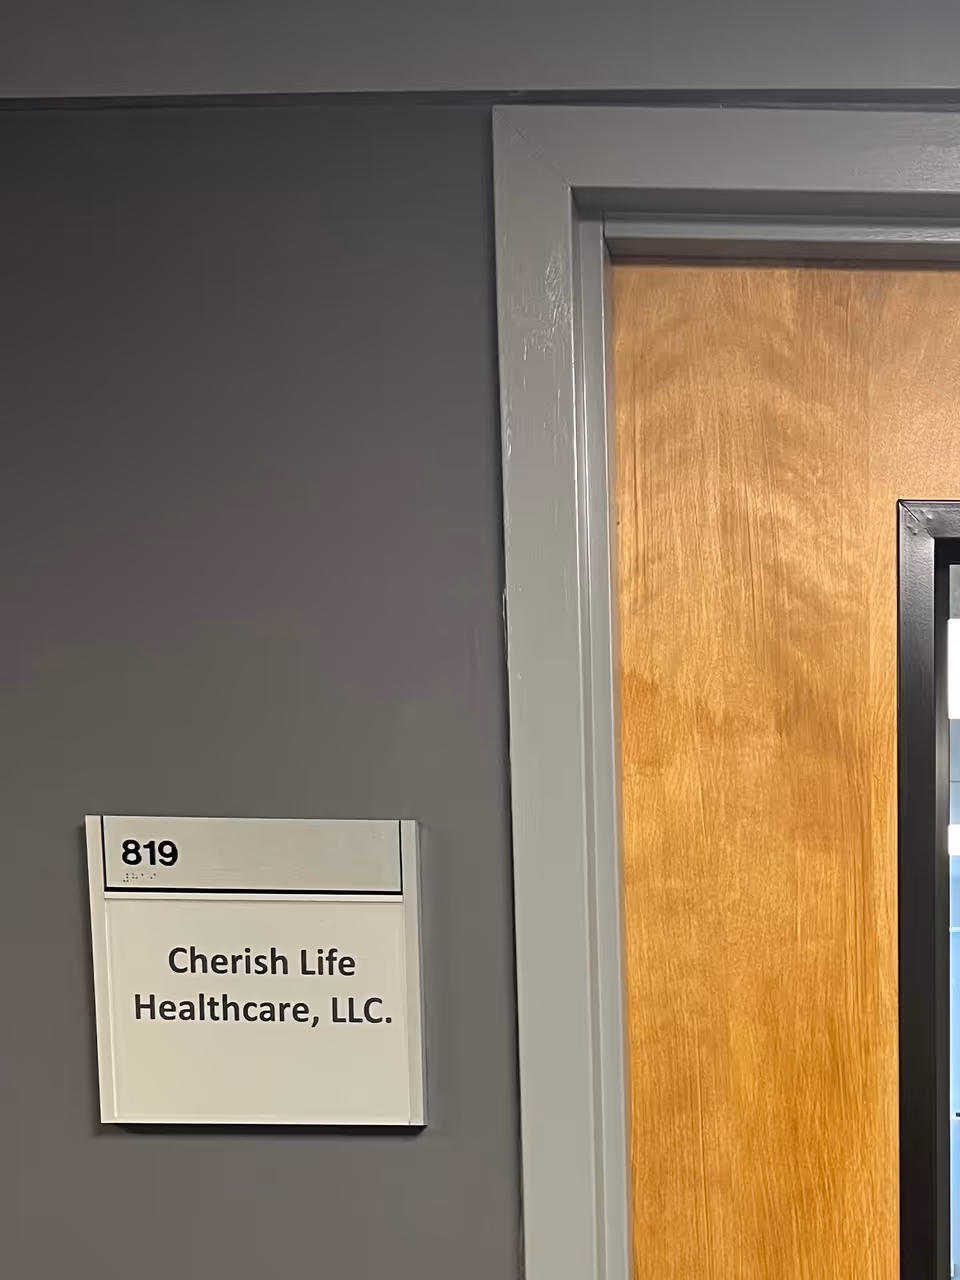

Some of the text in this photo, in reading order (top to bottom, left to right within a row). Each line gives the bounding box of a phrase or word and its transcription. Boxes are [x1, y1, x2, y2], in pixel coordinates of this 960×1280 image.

[121, 839, 178, 866] 819
[168, 946, 356, 976] Cherish Life
[134, 993, 392, 1028] Healthcare, LLC.
